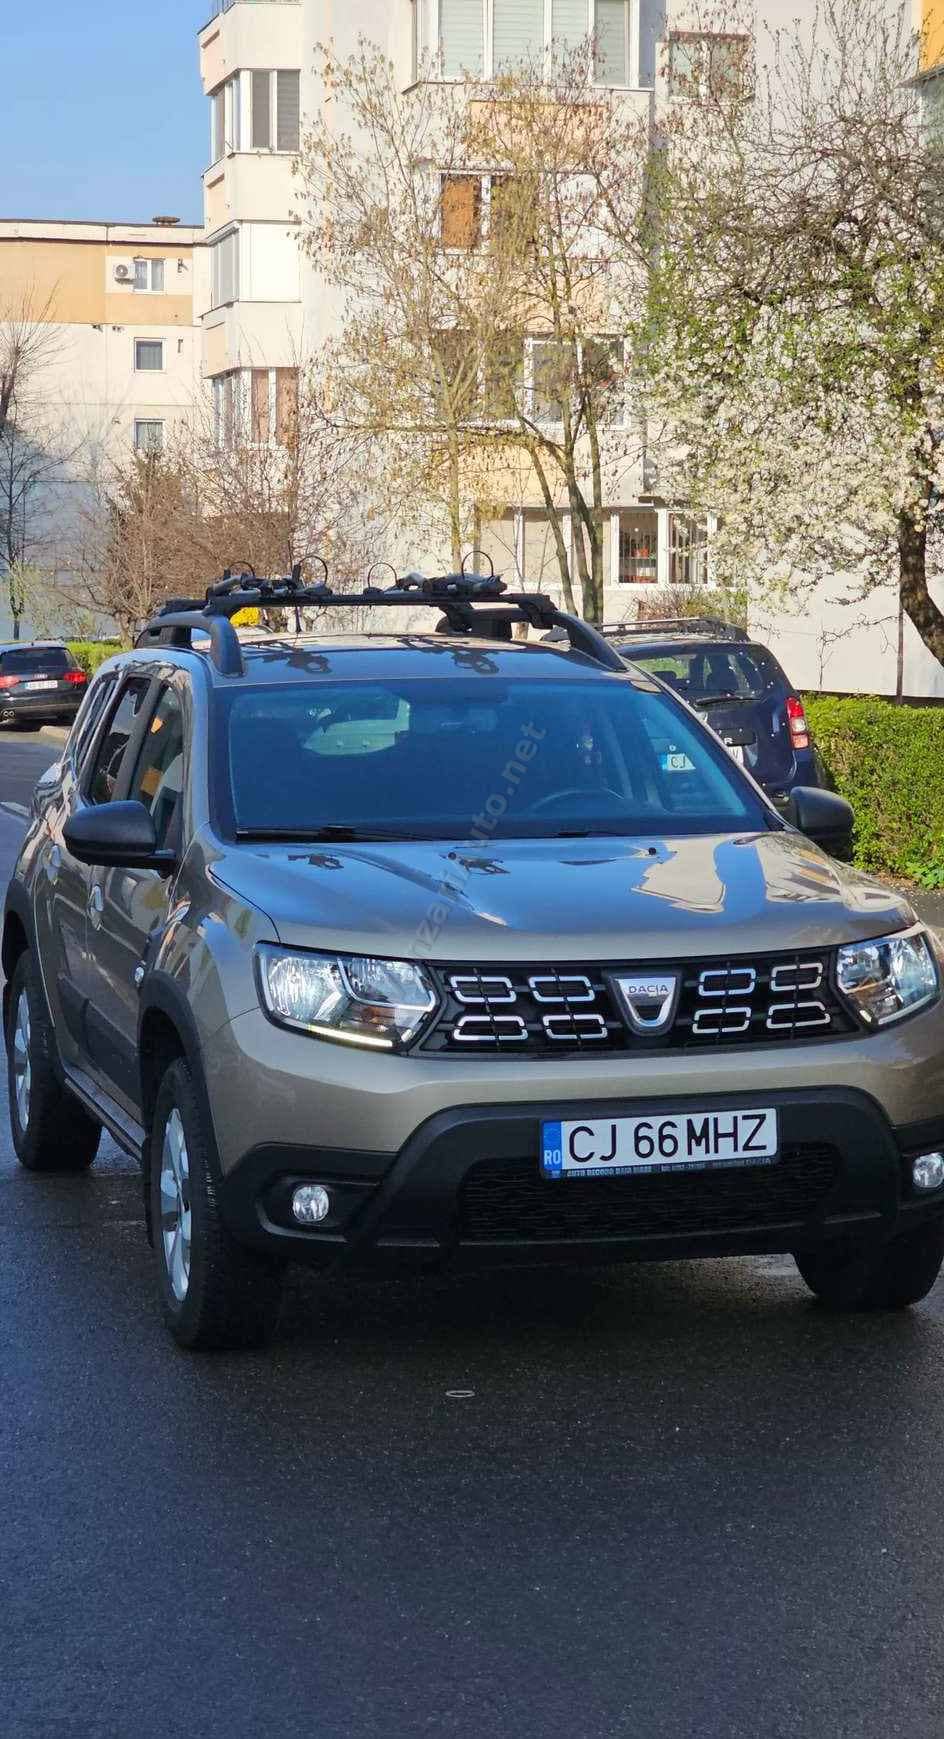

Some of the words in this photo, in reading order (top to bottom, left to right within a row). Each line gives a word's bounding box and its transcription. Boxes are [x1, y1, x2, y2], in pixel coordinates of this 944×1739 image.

[628, 984, 669, 994] DACIA
[569, 1124, 617, 1162] CJ
[543, 1150, 562, 1165] RO
